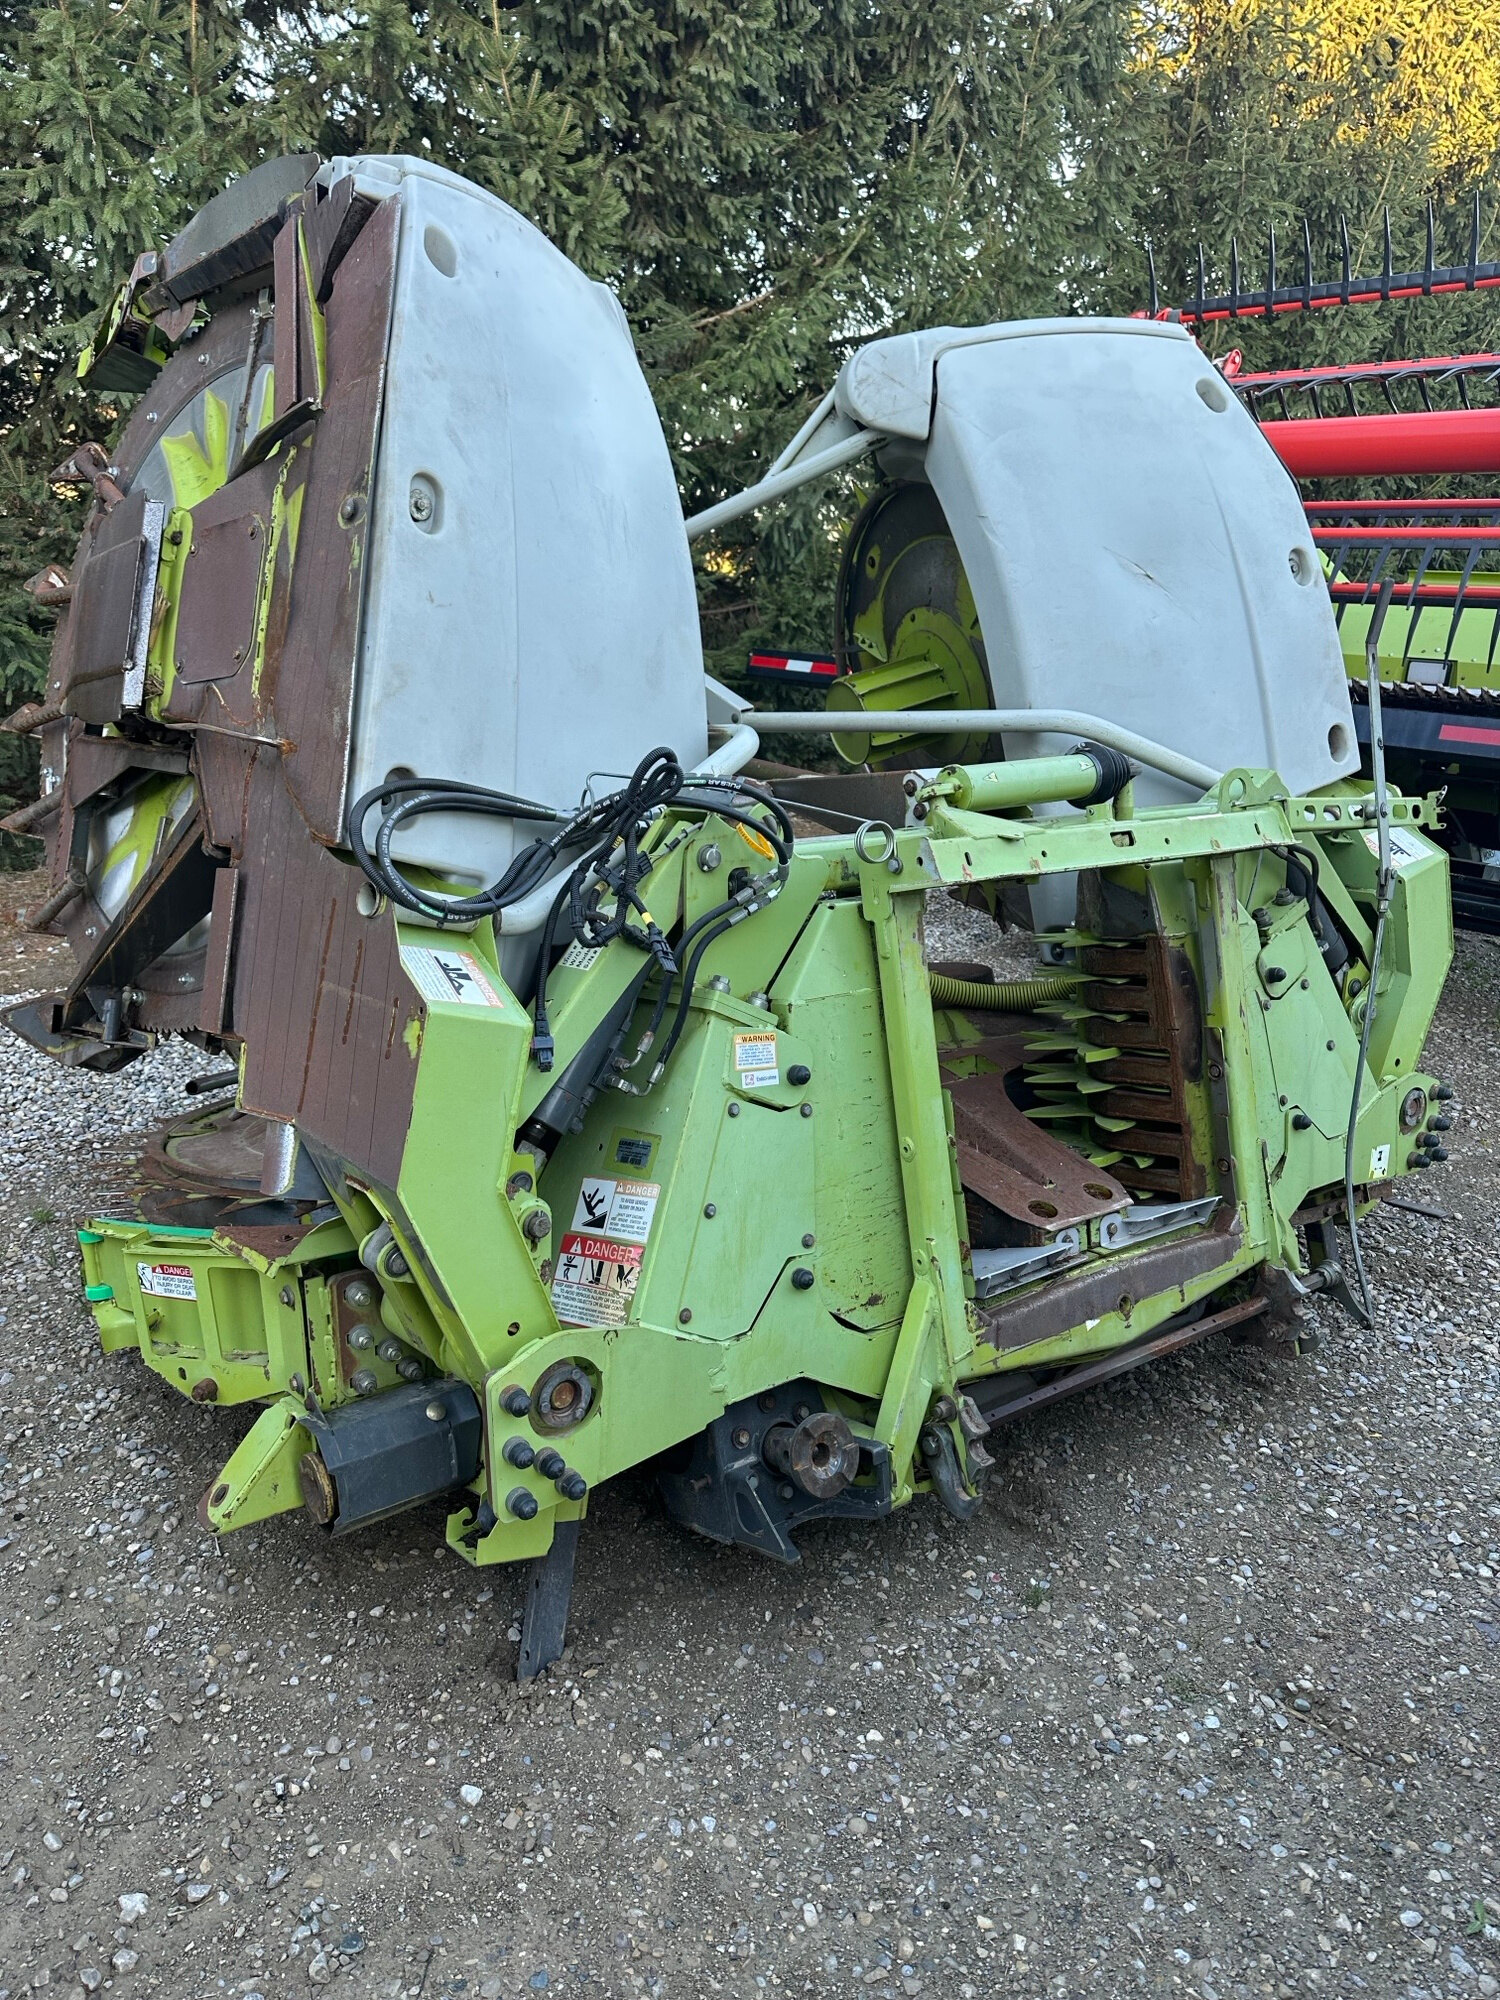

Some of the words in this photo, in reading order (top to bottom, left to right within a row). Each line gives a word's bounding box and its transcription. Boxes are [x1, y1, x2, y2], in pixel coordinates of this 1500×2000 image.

[707, 778, 743, 790] PULSAR
[741, 1034, 775, 1043] WARNING
[625, 1185, 658, 1198] DANGER
[584, 1240, 635, 1261] DANGER
